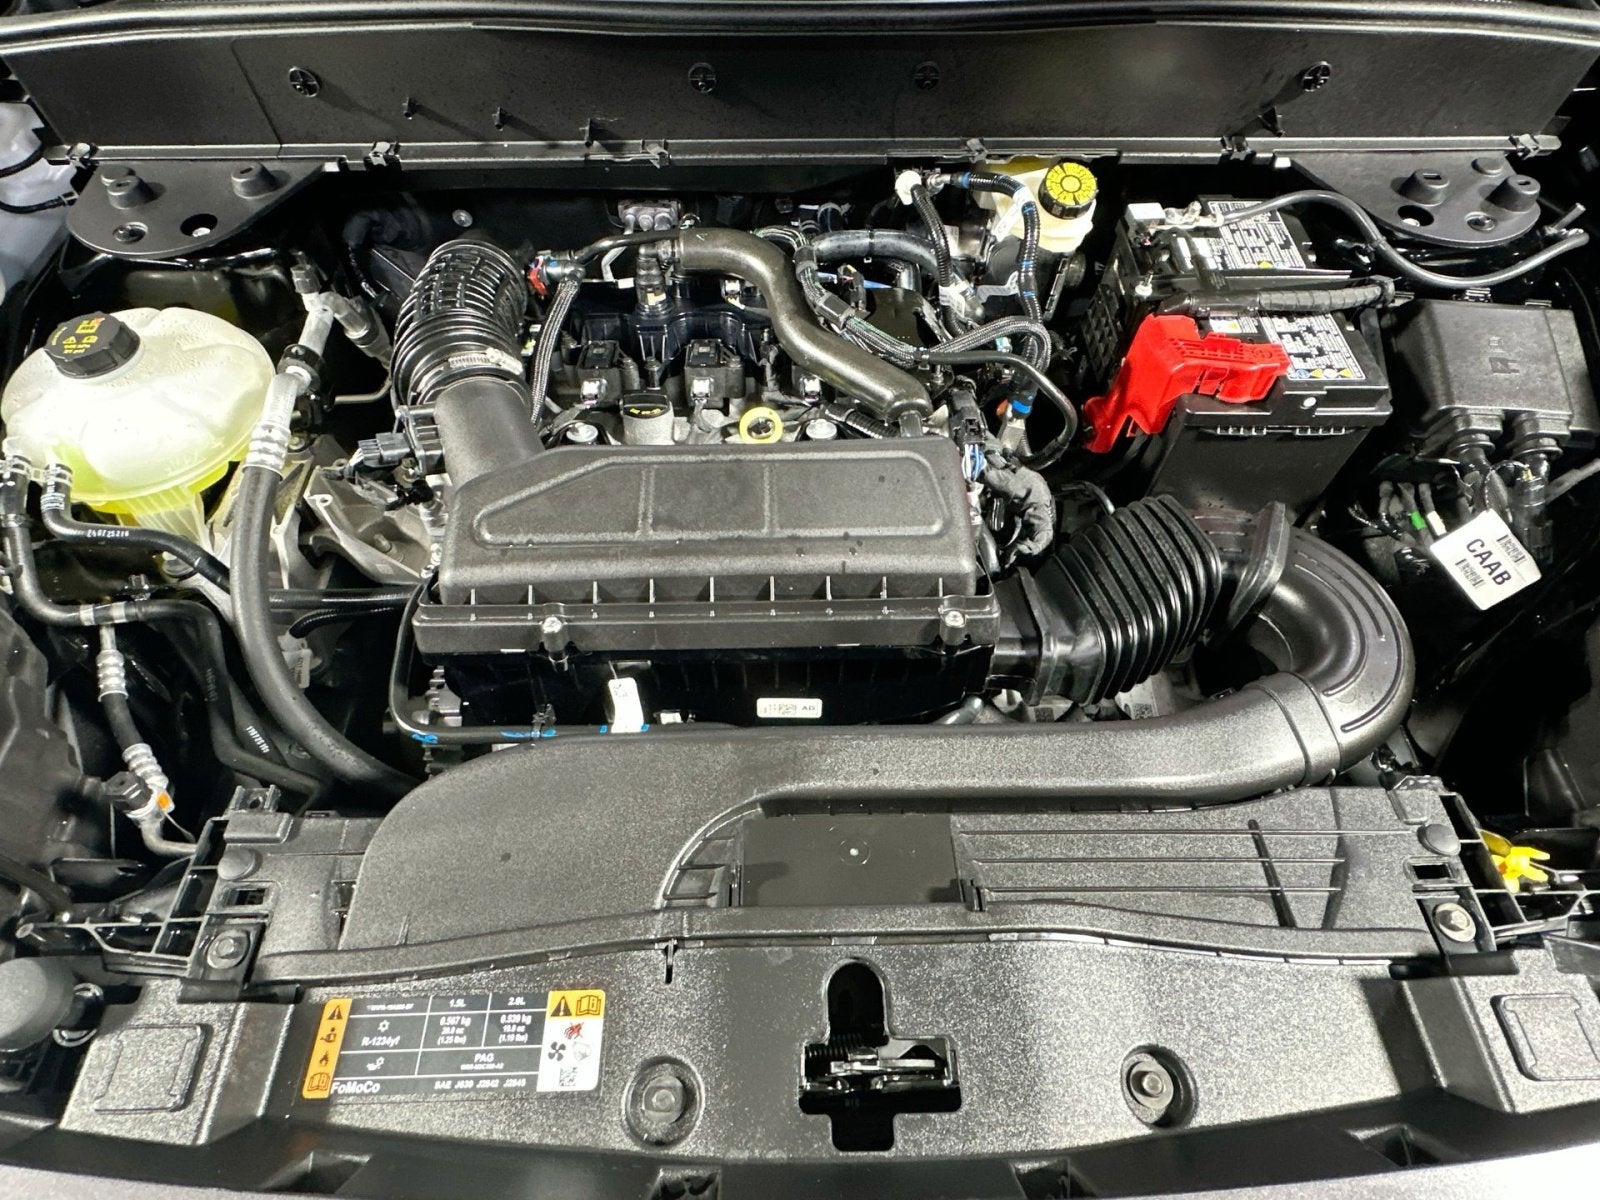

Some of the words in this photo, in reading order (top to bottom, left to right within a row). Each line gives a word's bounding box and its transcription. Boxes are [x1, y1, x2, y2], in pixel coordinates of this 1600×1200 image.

[1466, 538, 1512, 586] CAAB
[460, 1015, 472, 1027] kg
[521, 1013, 532, 1025] kg
[360, 1035, 401, 1048] R-1234yf
[474, 1053, 495, 1063] PAG
[330, 1080, 381, 1095] FoMoCo
